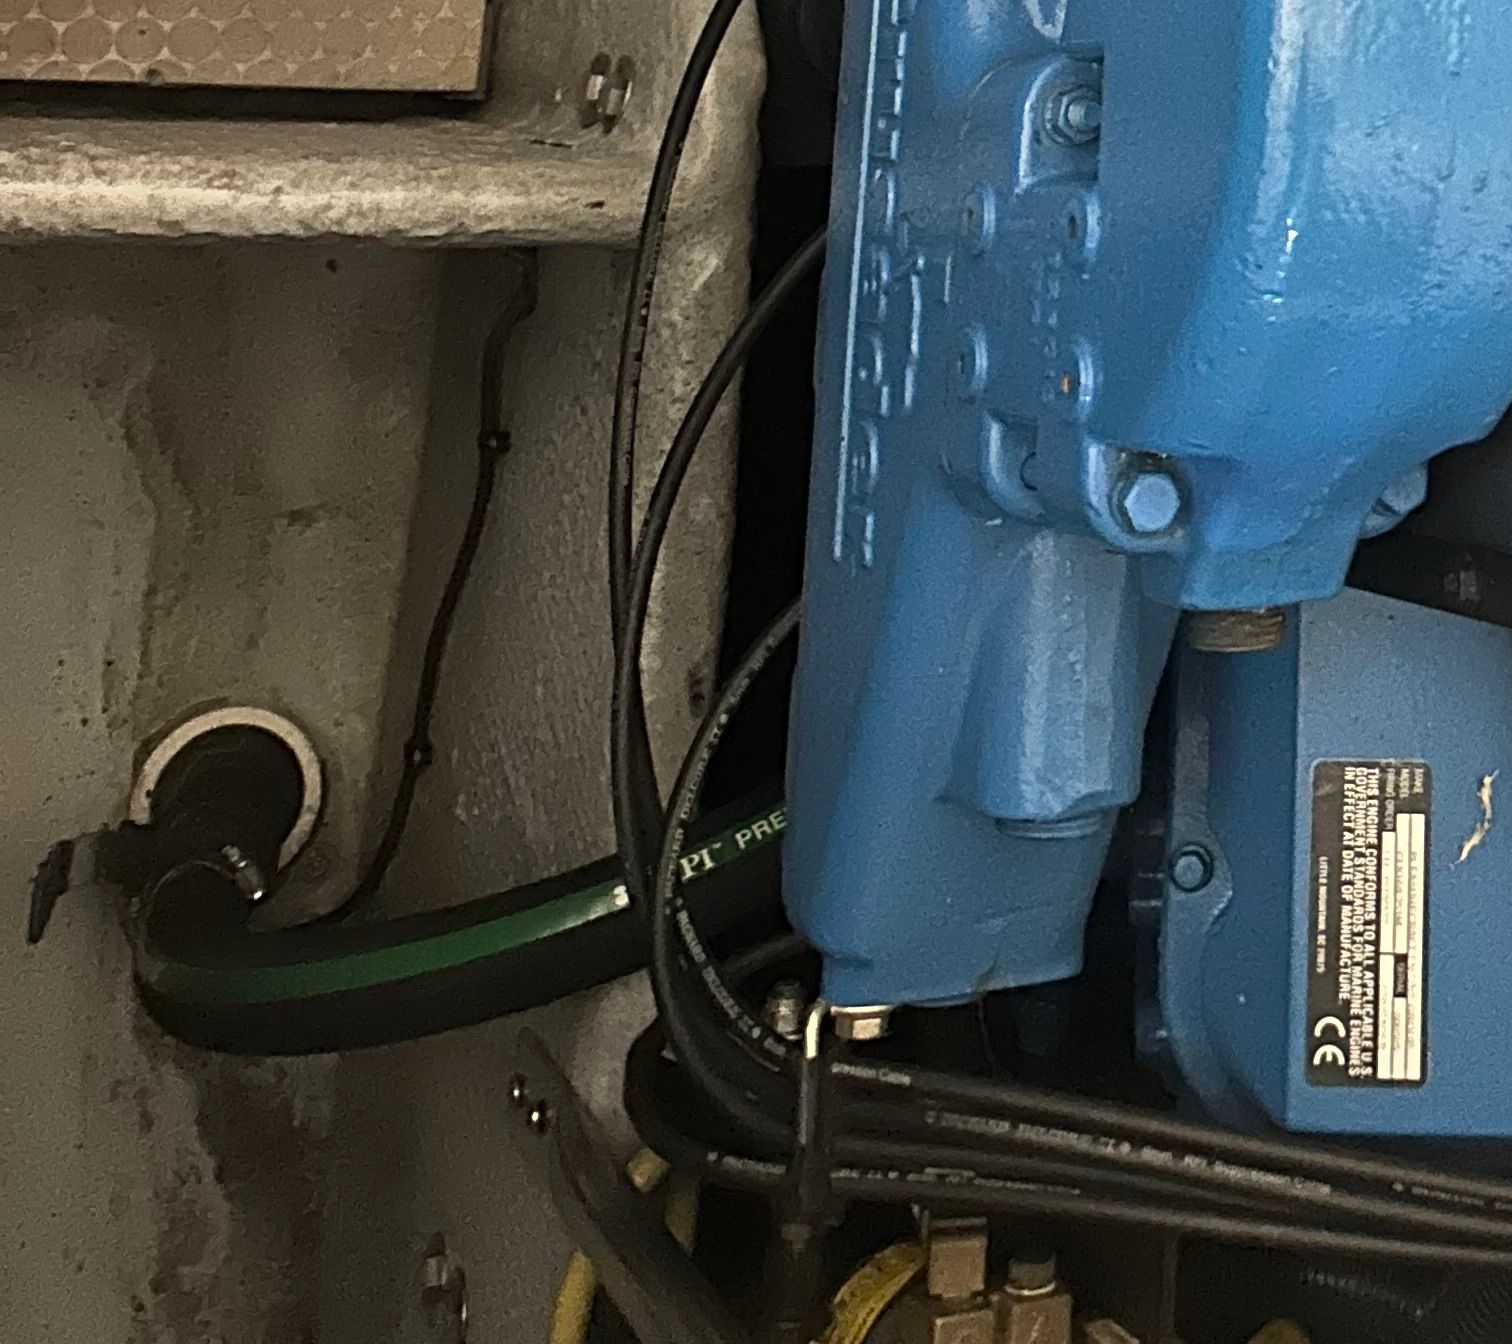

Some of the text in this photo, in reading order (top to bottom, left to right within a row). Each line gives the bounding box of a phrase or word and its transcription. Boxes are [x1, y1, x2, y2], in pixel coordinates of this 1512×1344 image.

[1344, 767, 1356, 779] IN
[1367, 767, 1379, 796] THIS
[1343, 783, 1355, 828] EFFECT
[1366, 799, 1378, 846] ENGINE
[1343, 832, 1353, 847] AT
[1341, 850, 1353, 881] DATE
[1341, 885, 1352, 902] OF
[1364, 849, 1377, 920] CONFORMS
[1348, 767, 1366, 1077] GOVERNMENT STANDARDS FOR MARINE ENGINES
[1365, 926, 1375, 940] TO
[1363, 944, 1374, 966] ALL
[1361, 970, 1373, 1048] APPLICABLE
[1313, 1016, 1345, 1066] CE
